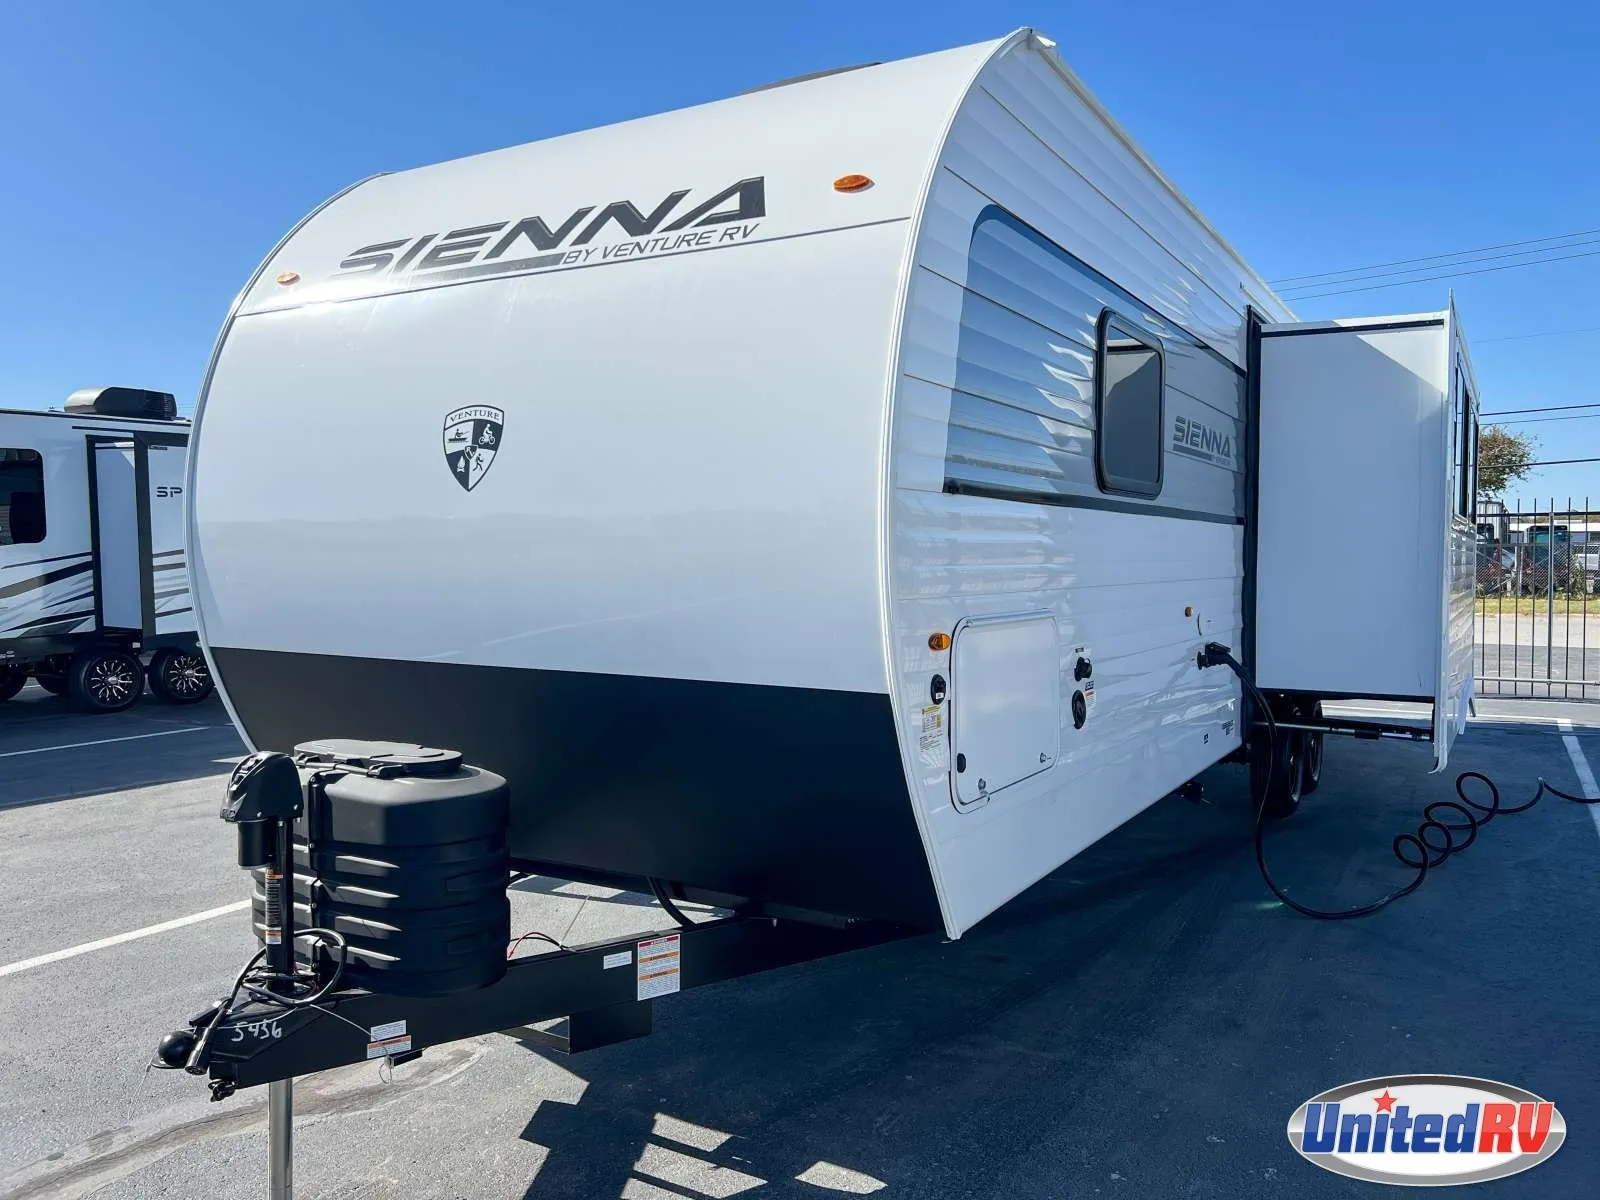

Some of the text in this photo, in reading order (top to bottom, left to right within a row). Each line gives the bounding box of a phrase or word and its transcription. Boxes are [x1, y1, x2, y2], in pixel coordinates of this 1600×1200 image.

[338, 176, 766, 275] SIENNA
[562, 222, 761, 265] BY VENTURE RV
[450, 409, 500, 422] VENTURE
[1173, 415, 1231, 458] SIENNA
